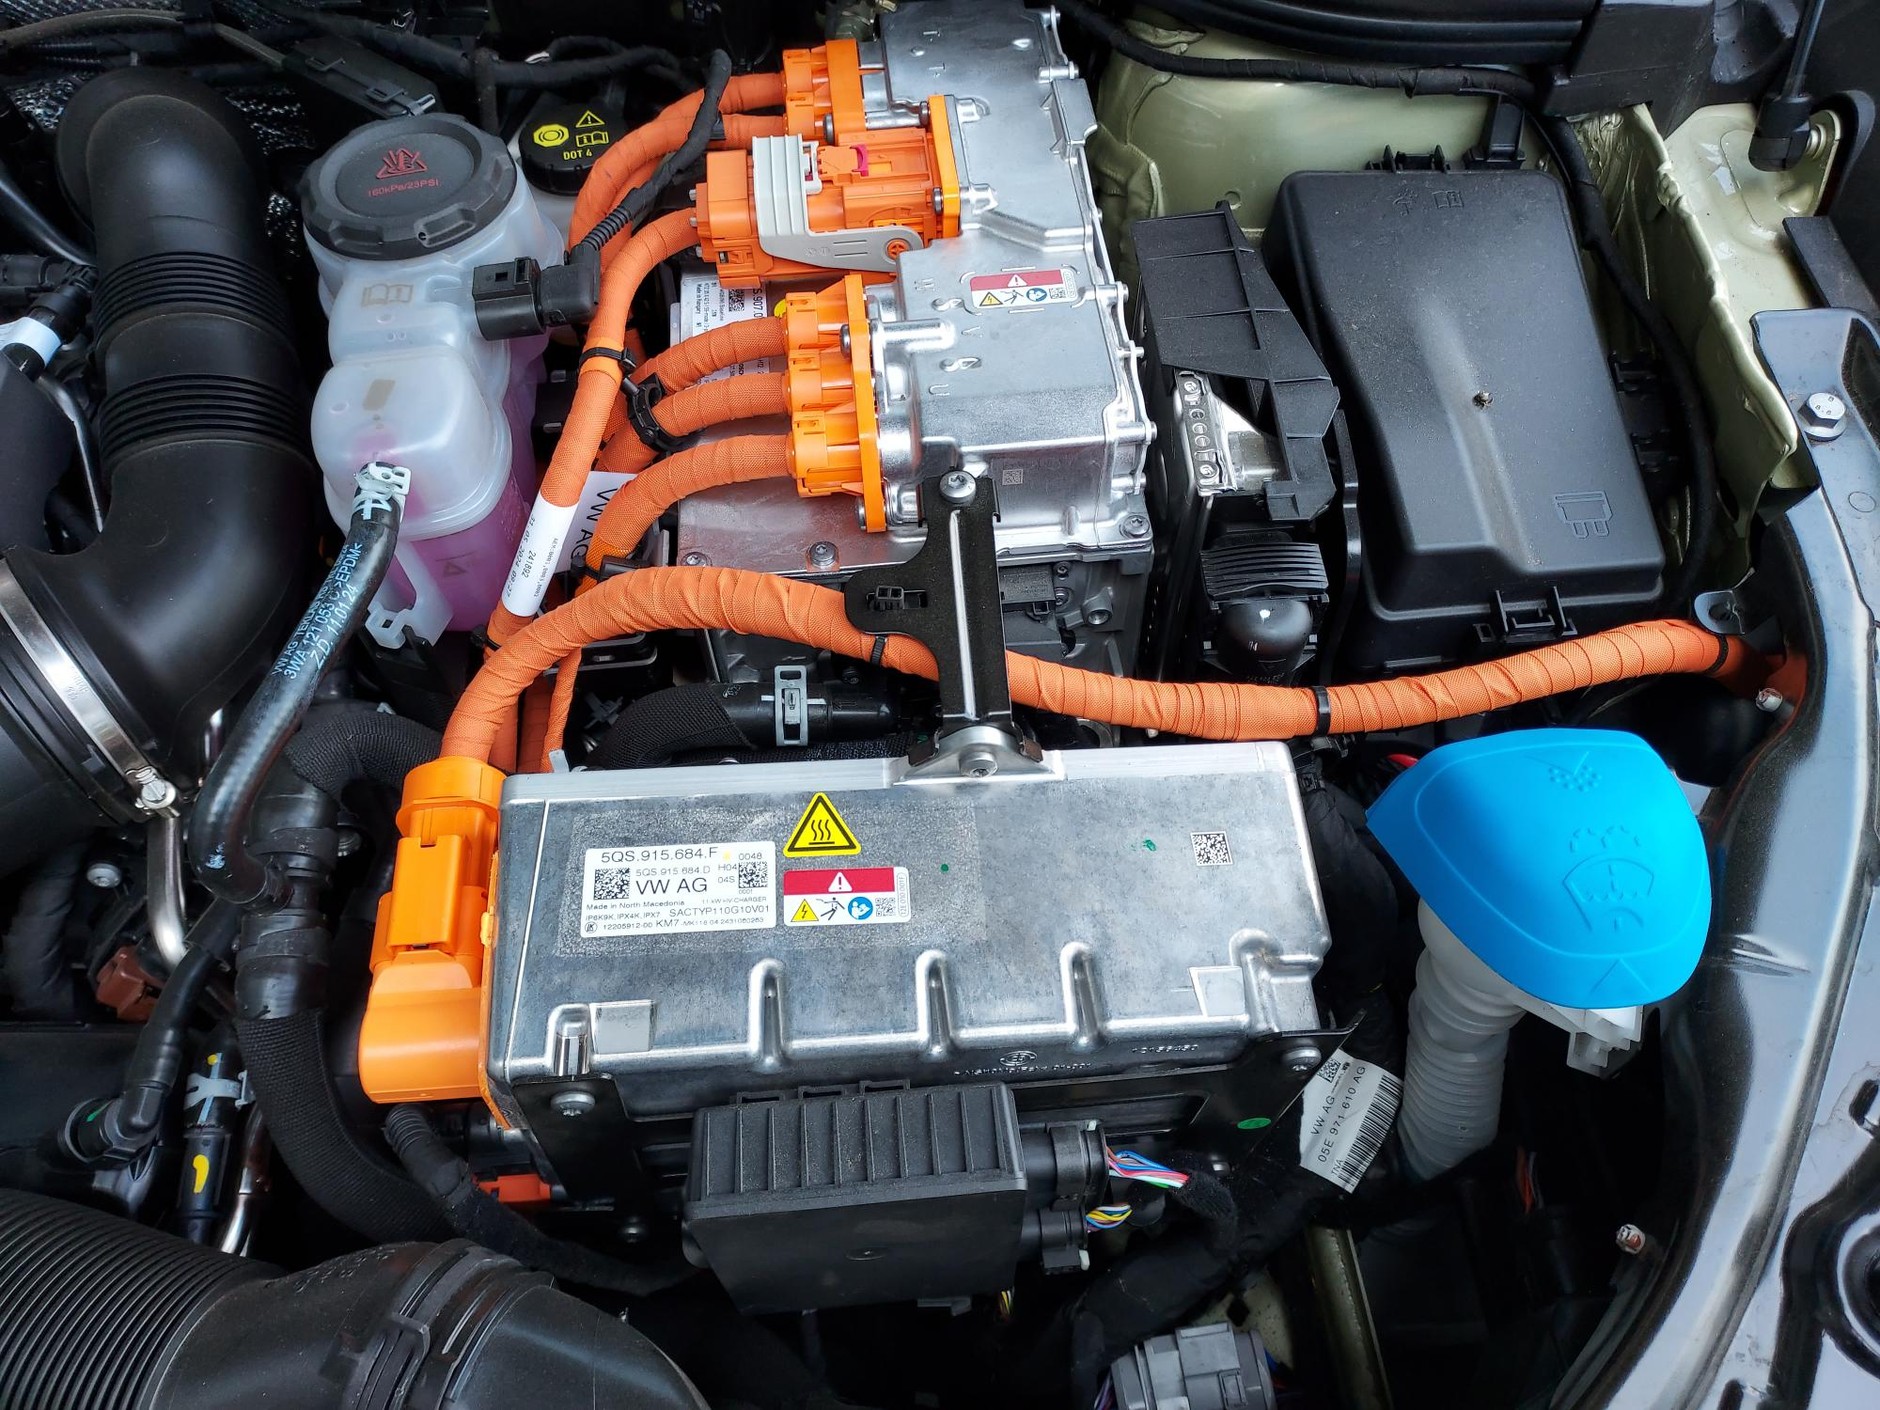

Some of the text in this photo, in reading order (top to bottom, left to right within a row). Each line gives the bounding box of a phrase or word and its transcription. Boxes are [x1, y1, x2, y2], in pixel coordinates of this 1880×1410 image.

[562, 148, 593, 161] DOT 4
[368, 178, 440, 198] 160kPa/23PSI
[752, 288, 764, 318] S.907.0
[570, 528, 594, 562] AG
[328, 584, 358, 636] 11.01.24
[282, 641, 299, 657] AG
[284, 649, 311, 679] 3WA
[305, 625, 323, 647] 121
[318, 602, 335, 626] 053
[601, 846, 718, 863] 5QS.915.684.F
[738, 852, 763, 860] 0048
[718, 864, 738, 872] H04
[636, 878, 708, 896] VW AG
[718, 876, 736, 884] 04S
[644, 900, 685, 908] Macedonia
[656, 918, 679, 928] KM7
[1310, 1095, 1335, 1136] VW AG
[1318, 1066, 1366, 1162] 05E 971 610 AG
